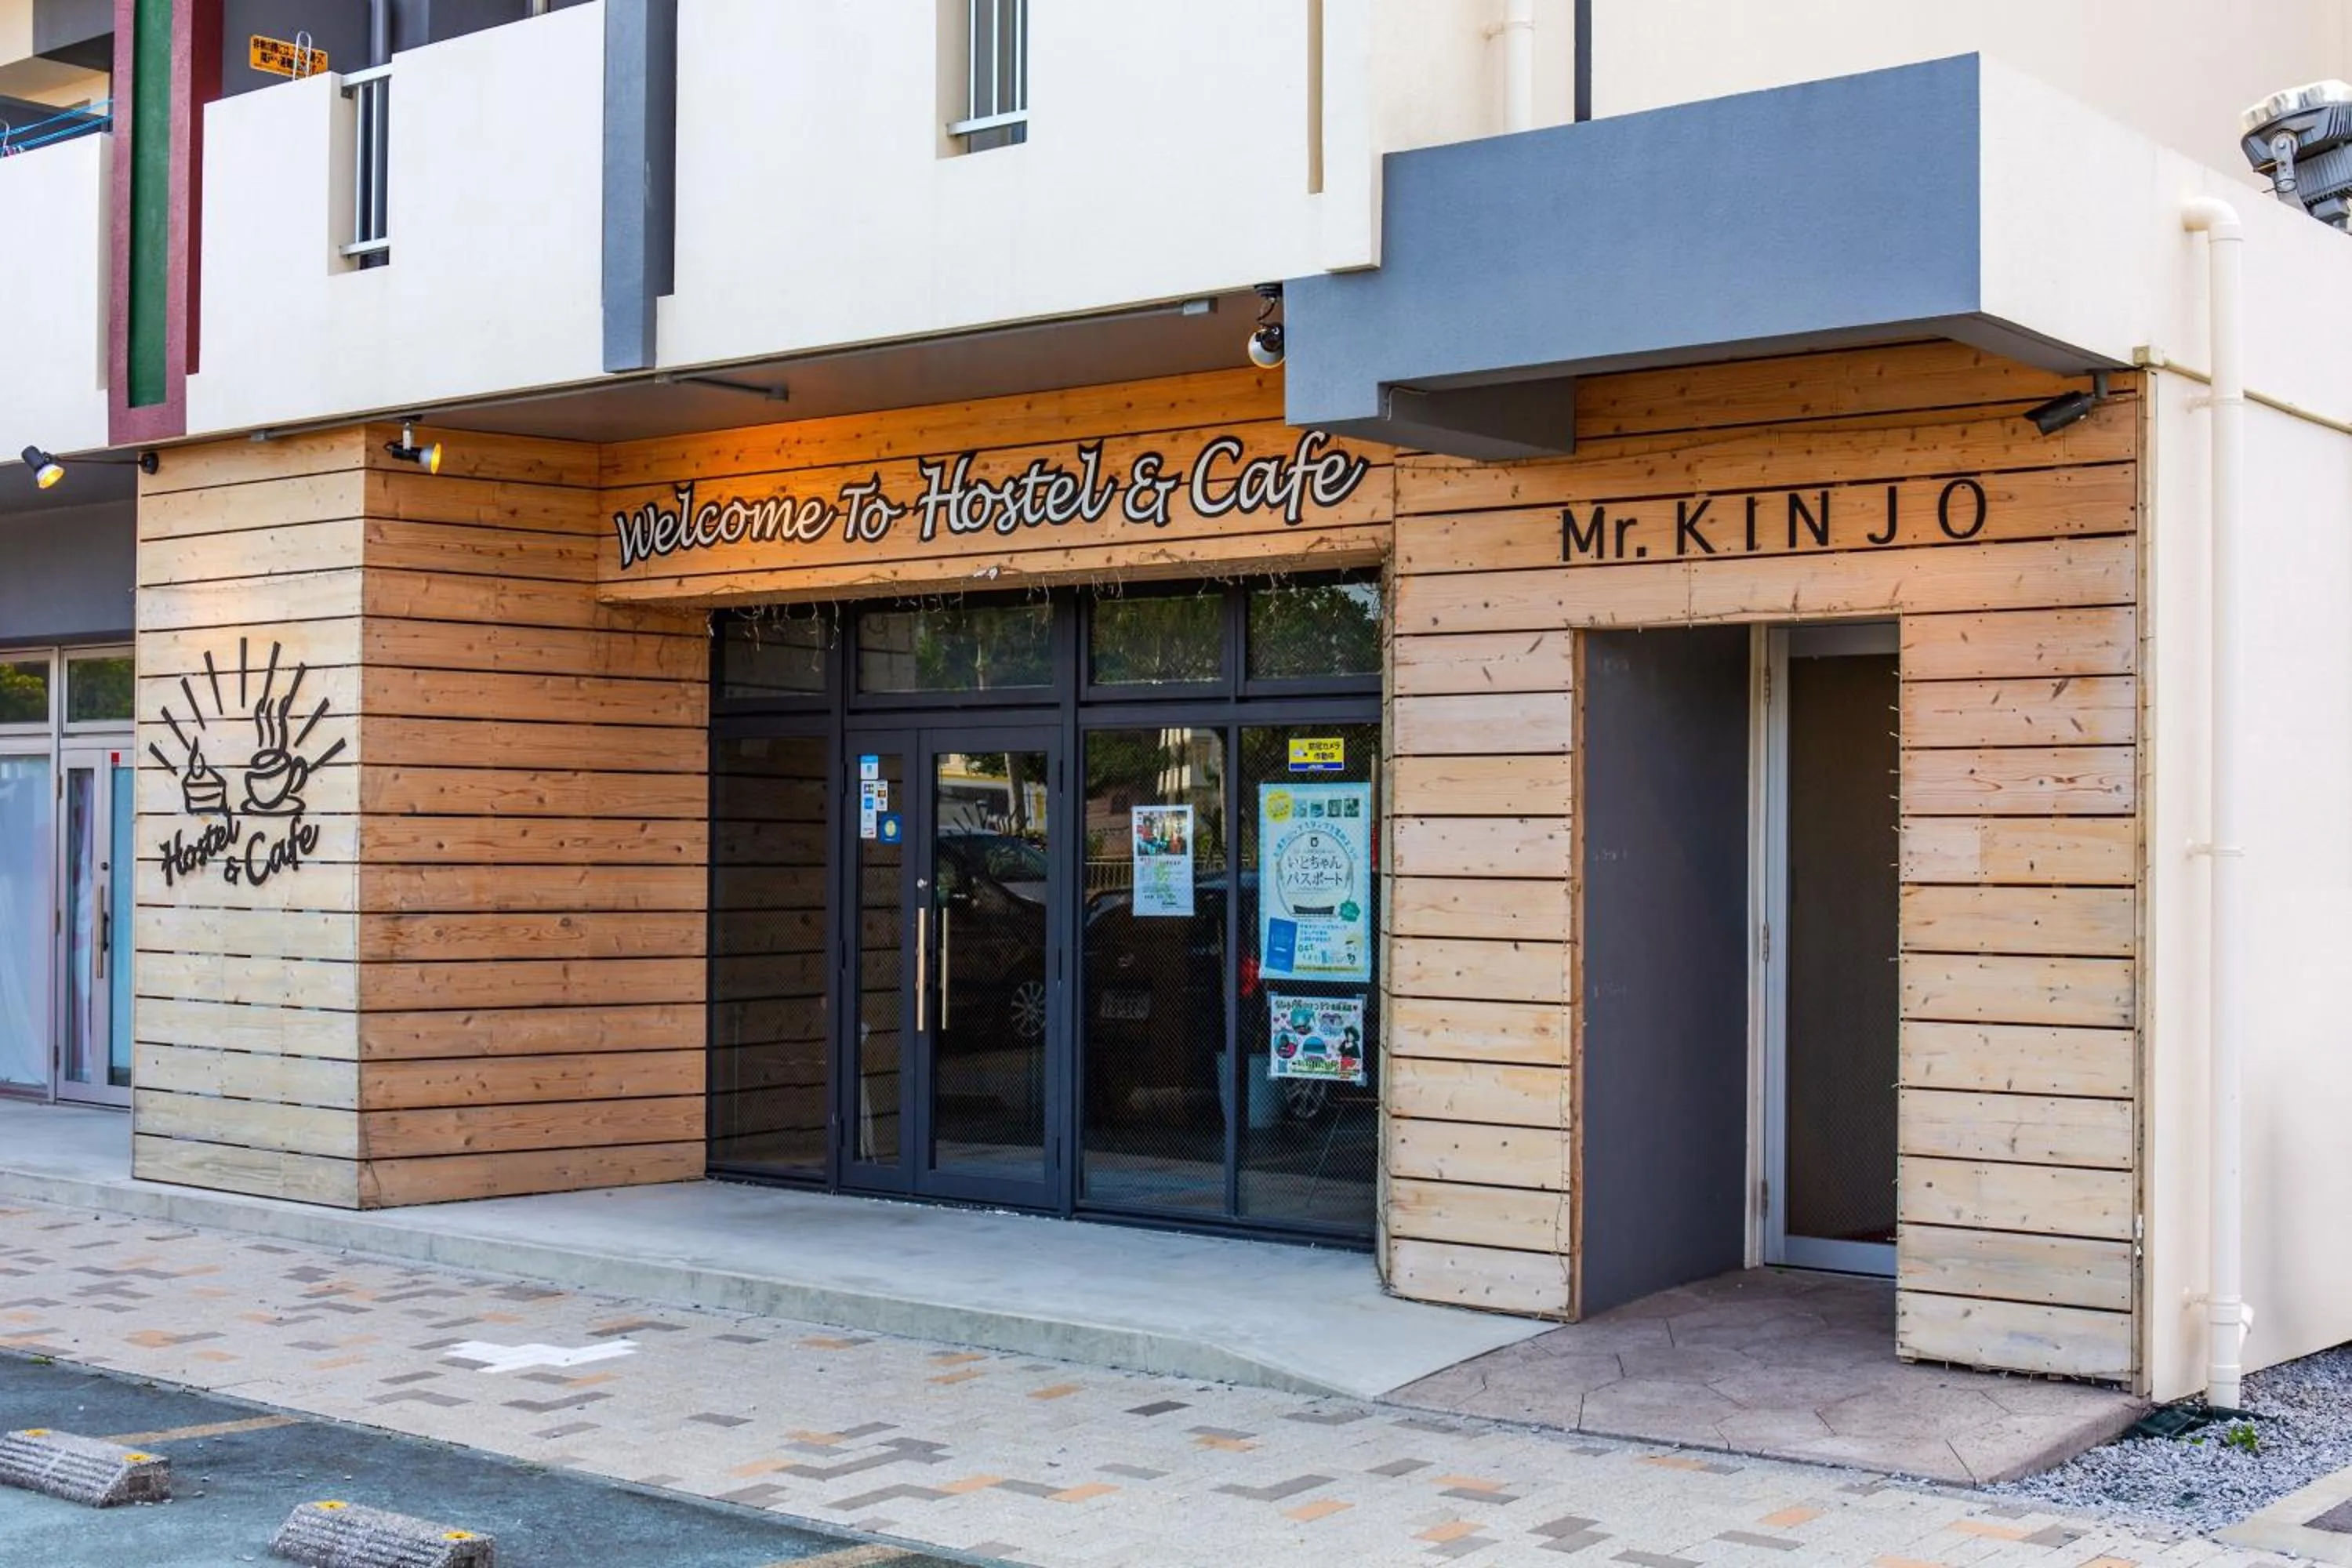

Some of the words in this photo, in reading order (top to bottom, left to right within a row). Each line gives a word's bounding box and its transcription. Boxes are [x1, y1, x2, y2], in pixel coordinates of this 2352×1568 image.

[613, 480, 839, 570] Welcome
[838, 470, 905, 543] To
[912, 439, 1119, 542] Hostel
[1123, 452, 1182, 528] &
[1189, 430, 1370, 525] Cafe
[1561, 506, 1646, 561] Mr.
[1676, 478, 1987, 555] KINJO
[159, 806, 240, 886] Hostel
[223, 856, 241, 884] &
[245, 815, 319, 886] Cafe
[1287, 855, 1342, 870] いとちゃん
[1287, 871, 1343, 886] パスポート
